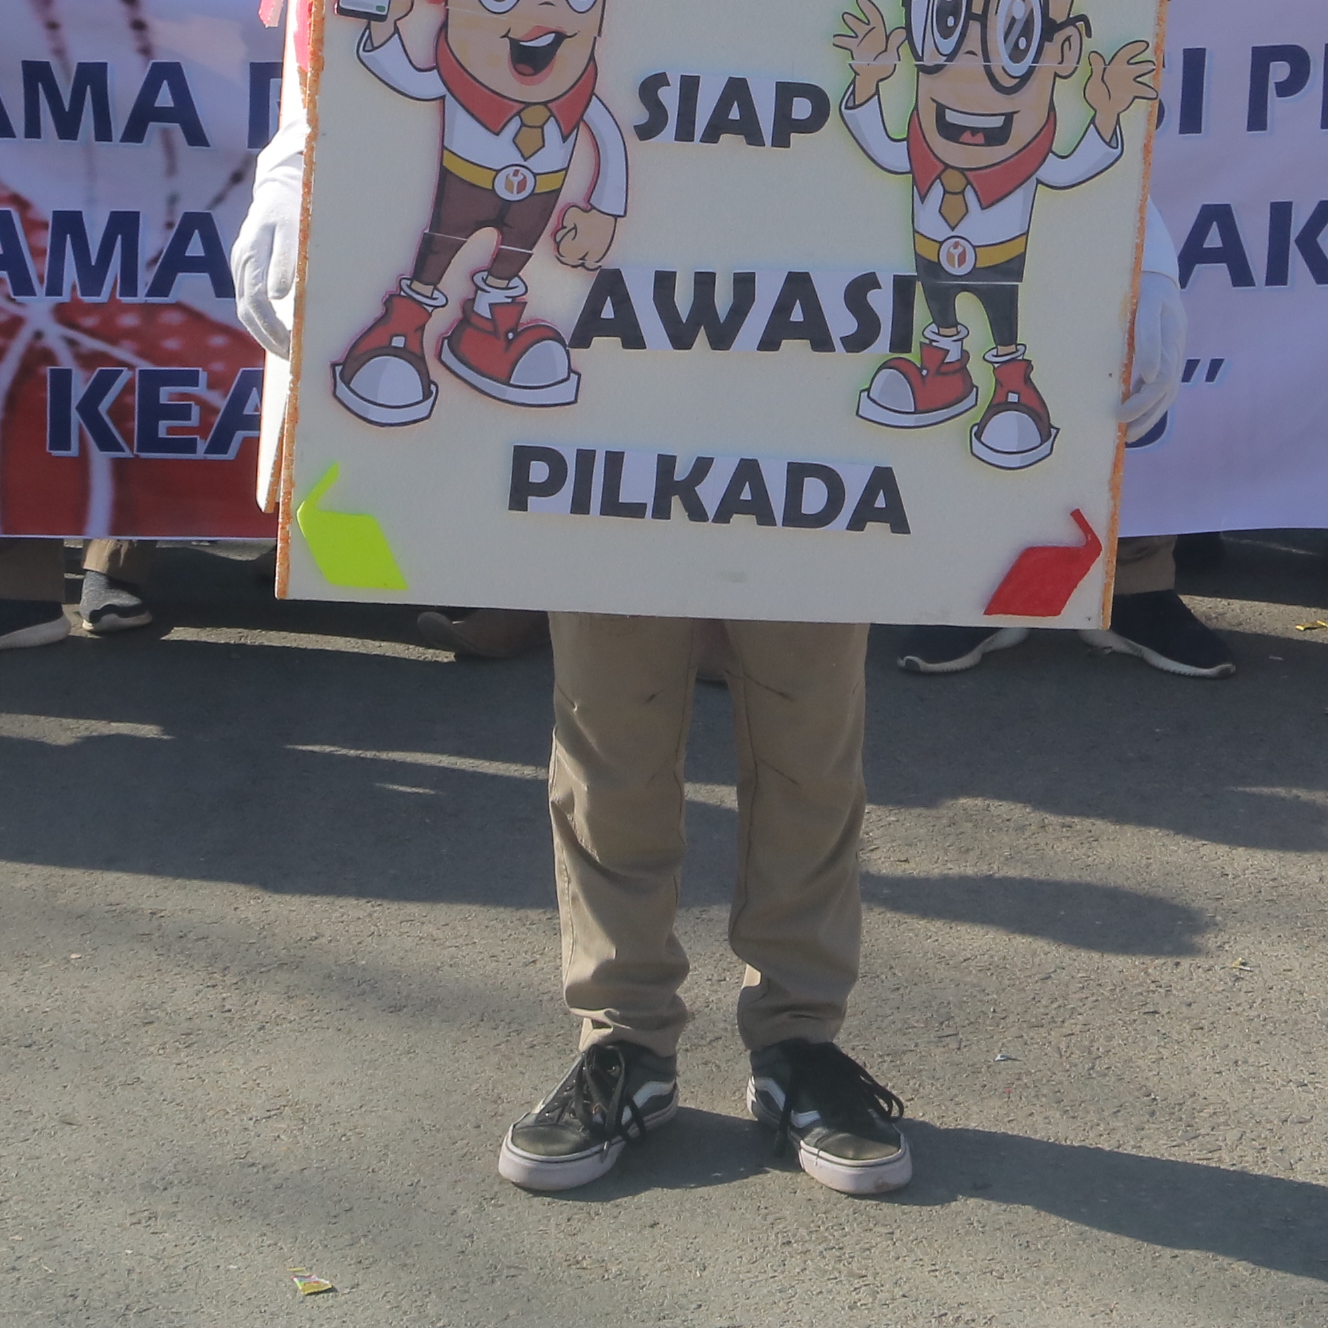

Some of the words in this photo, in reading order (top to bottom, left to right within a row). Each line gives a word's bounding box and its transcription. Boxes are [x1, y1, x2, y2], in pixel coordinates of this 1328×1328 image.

[633, 72, 831, 149] SIAP
[566, 268, 921, 354] AWASI
[507, 445, 911, 535] PILKADA
